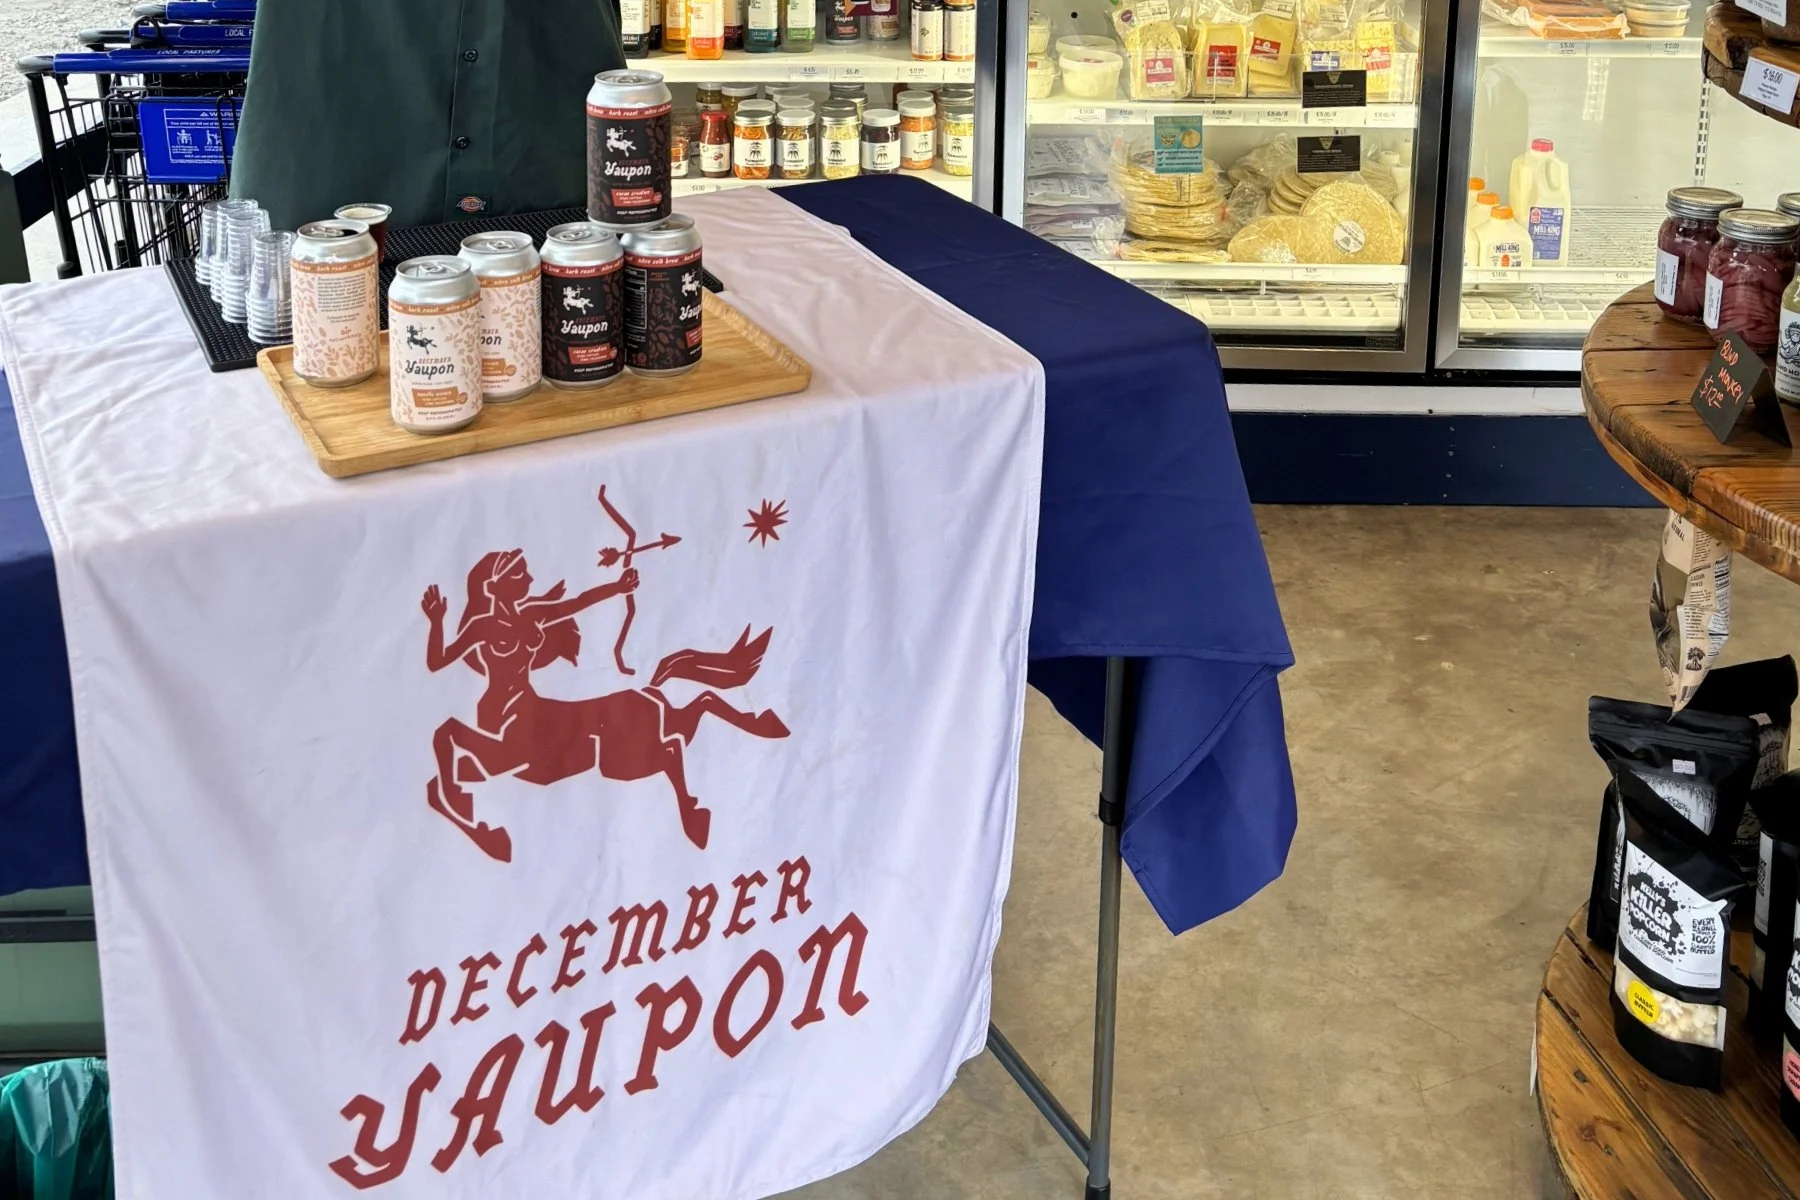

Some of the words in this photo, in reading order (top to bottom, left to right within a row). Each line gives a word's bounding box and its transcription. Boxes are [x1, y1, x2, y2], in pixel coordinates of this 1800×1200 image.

[224, 29, 246, 37] LOCAL
[604, 161, 652, 181] Yaupon
[679, 304, 702, 320] Yaup
[560, 319, 608, 339] Yaupon
[481, 335, 502, 346] pon
[405, 359, 454, 380] Yaupon
[1718, 366, 1744, 404] MONKEY
[1640, 881, 1666, 907] KELLY'S
[1629, 885, 1673, 931] KILLER
[1629, 902, 1671, 943] POPCORN
[1692, 916, 1716, 926] EVERY
[1692, 933, 1716, 946] 100%
[399, 855, 813, 1045] DECEMBER
[1633, 999, 1654, 1018] BUTTER
[1634, 992, 1654, 1011] CLASSIC
[329, 911, 870, 1189] YAUPON
